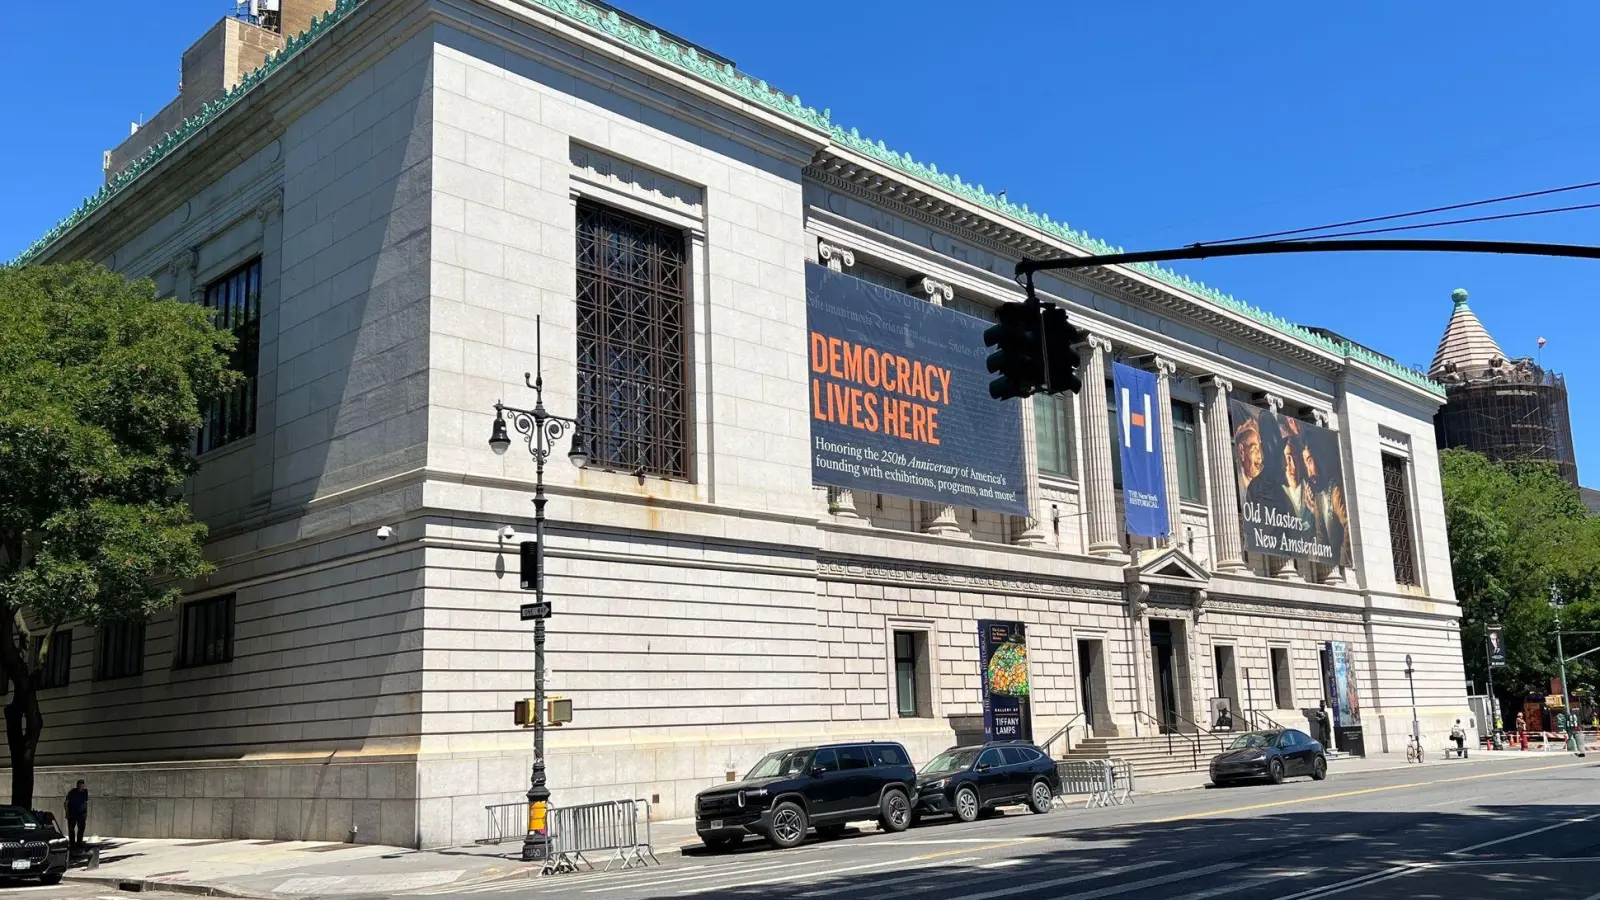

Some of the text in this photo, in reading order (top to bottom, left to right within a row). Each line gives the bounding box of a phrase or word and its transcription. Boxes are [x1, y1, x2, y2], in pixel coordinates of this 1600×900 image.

[811, 331, 951, 405] DEMOCRACY
[813, 378, 879, 432] LIVES
[883, 396, 940, 445] HERE
[815, 436, 1006, 486] Honoring the 250th Anniversary of America's
[815, 455, 1016, 503] founding with exhibitions, programs, and more!
[1128, 489, 1158, 502] THE New York
[1129, 497, 1160, 509] HISTORICAL
[1243, 501, 1303, 531] Old Masters
[1253, 527, 1333, 558] New Amsterdam
[524, 608, 534, 616] ONE
[995, 717, 1019, 726] TIFFANY
[995, 726, 1016, 735] LAMPS
